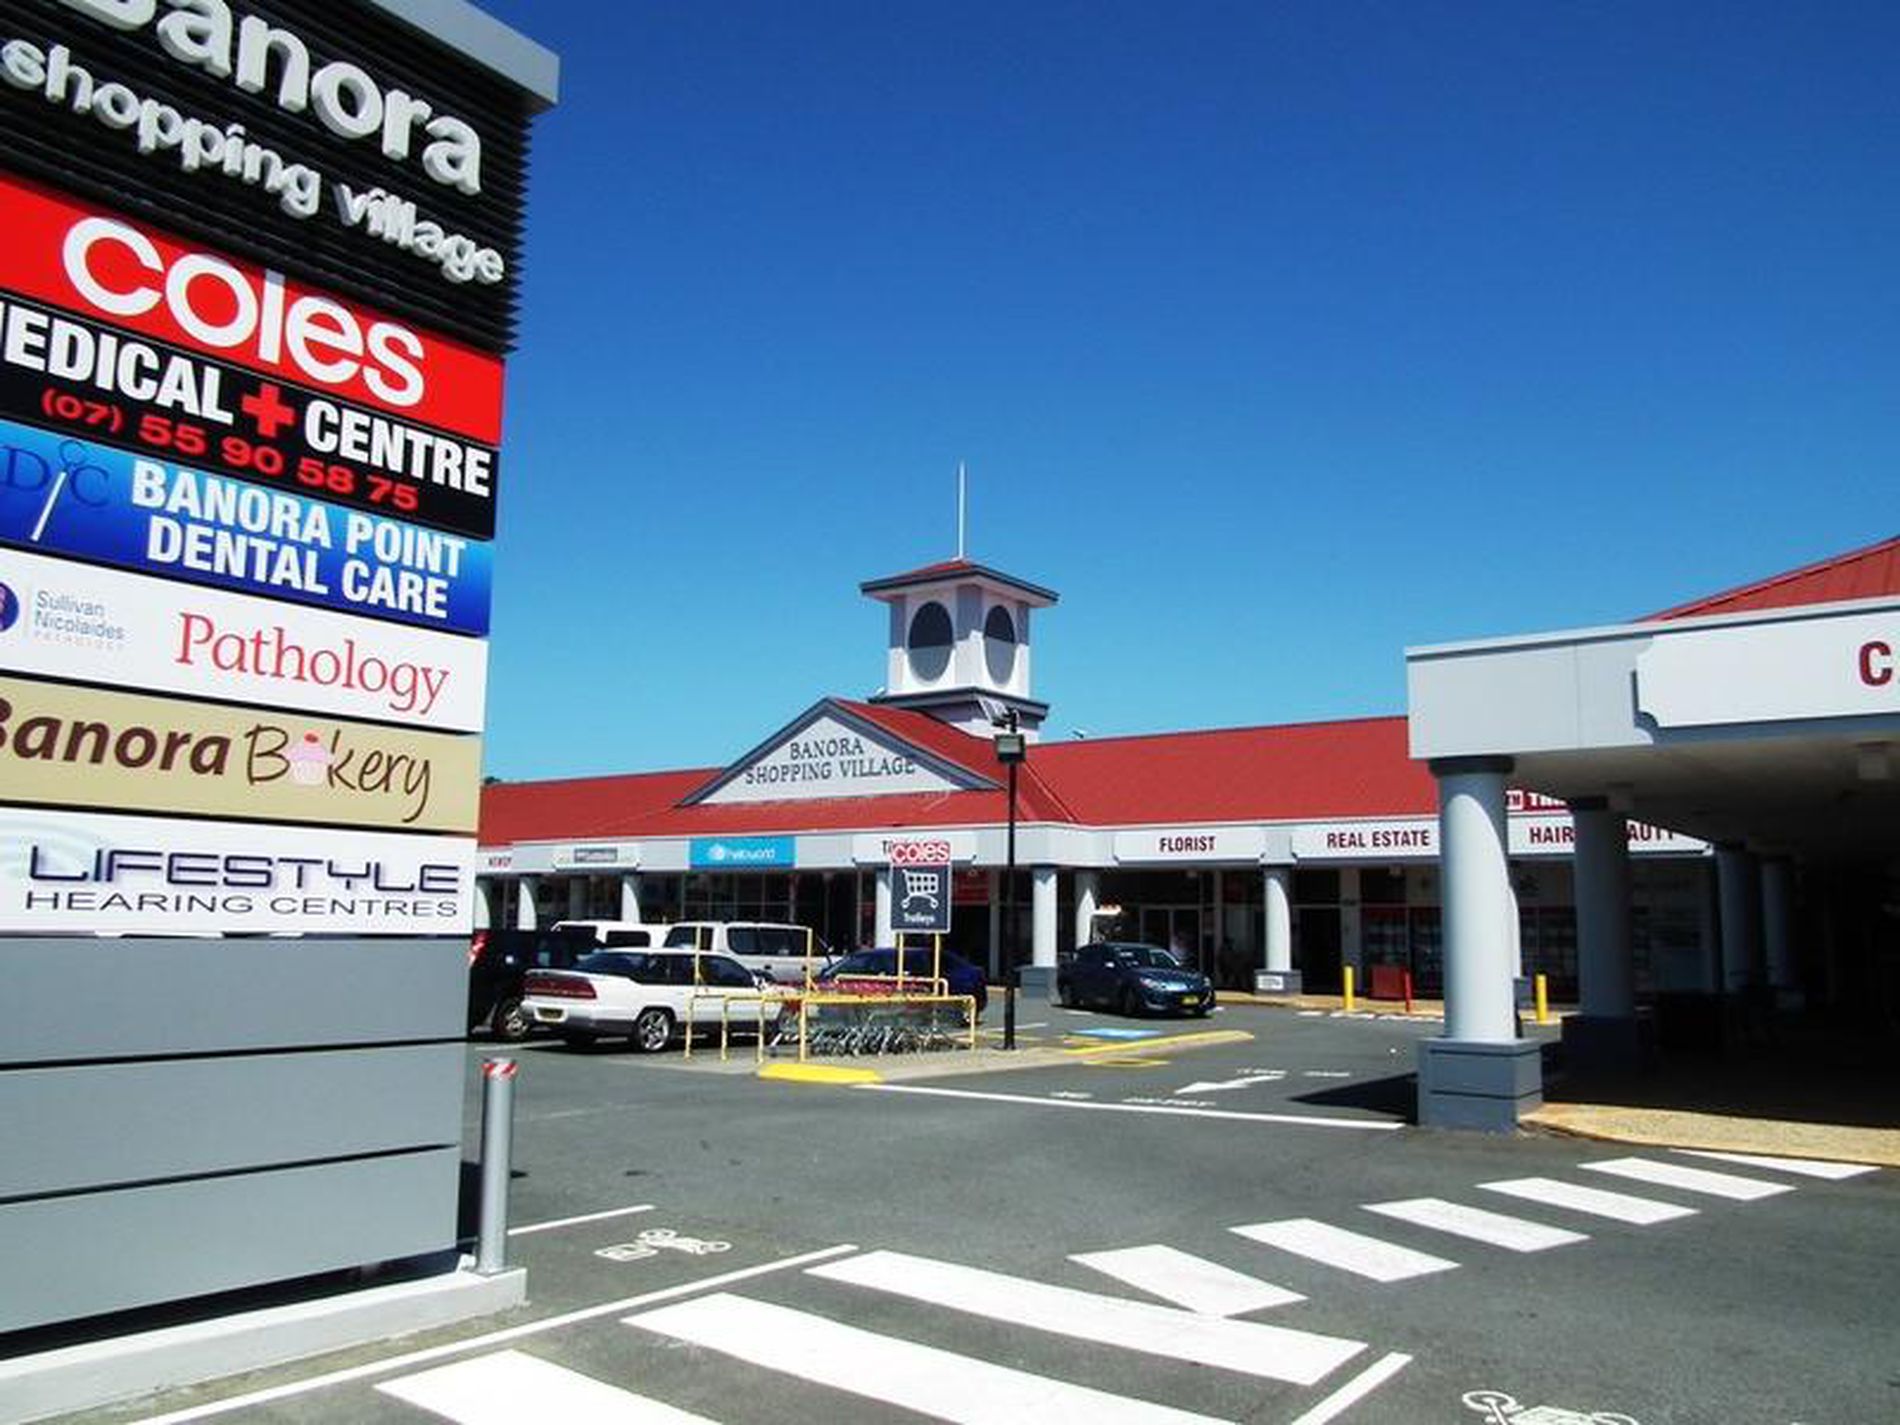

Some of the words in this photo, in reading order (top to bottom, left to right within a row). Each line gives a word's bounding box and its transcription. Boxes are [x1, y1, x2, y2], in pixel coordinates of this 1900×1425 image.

[0, 39, 321, 219] shopping
[332, 181, 504, 285] village
[62, 216, 425, 407] coles
[0, 302, 234, 426] EDICAL
[304, 399, 491, 497] CENTRE
[41, 388, 123, 432] (07)
[139, 414, 207, 456] 55
[222, 438, 284, 476] 90
[297, 460, 355, 495] 58
[366, 474, 418, 512] 75
[132, 460, 332, 549] BANORA
[346, 511, 466, 578] POINT
[147, 515, 328, 595] DENTAL
[342, 559, 449, 619] CARE
[175, 612, 450, 715] Pathology
[1859, 641, 1900, 686] C
[244, 723, 431, 822] Bkery
[745, 761, 832, 785] SHOPPING
[840, 756, 916, 778] VILLAGE
[789, 737, 865, 762] BANORA
[892, 842, 950, 863] coles
[1160, 836, 1216, 852] FLORIST
[1327, 832, 1366, 848] REAL
[1372, 829, 1430, 847] ESTATE
[1529, 827, 1574, 843] HAIR
[29, 845, 460, 893] LIFESTYLE
[25, 890, 253, 913] HEARING
[270, 896, 458, 917] CENTRES
